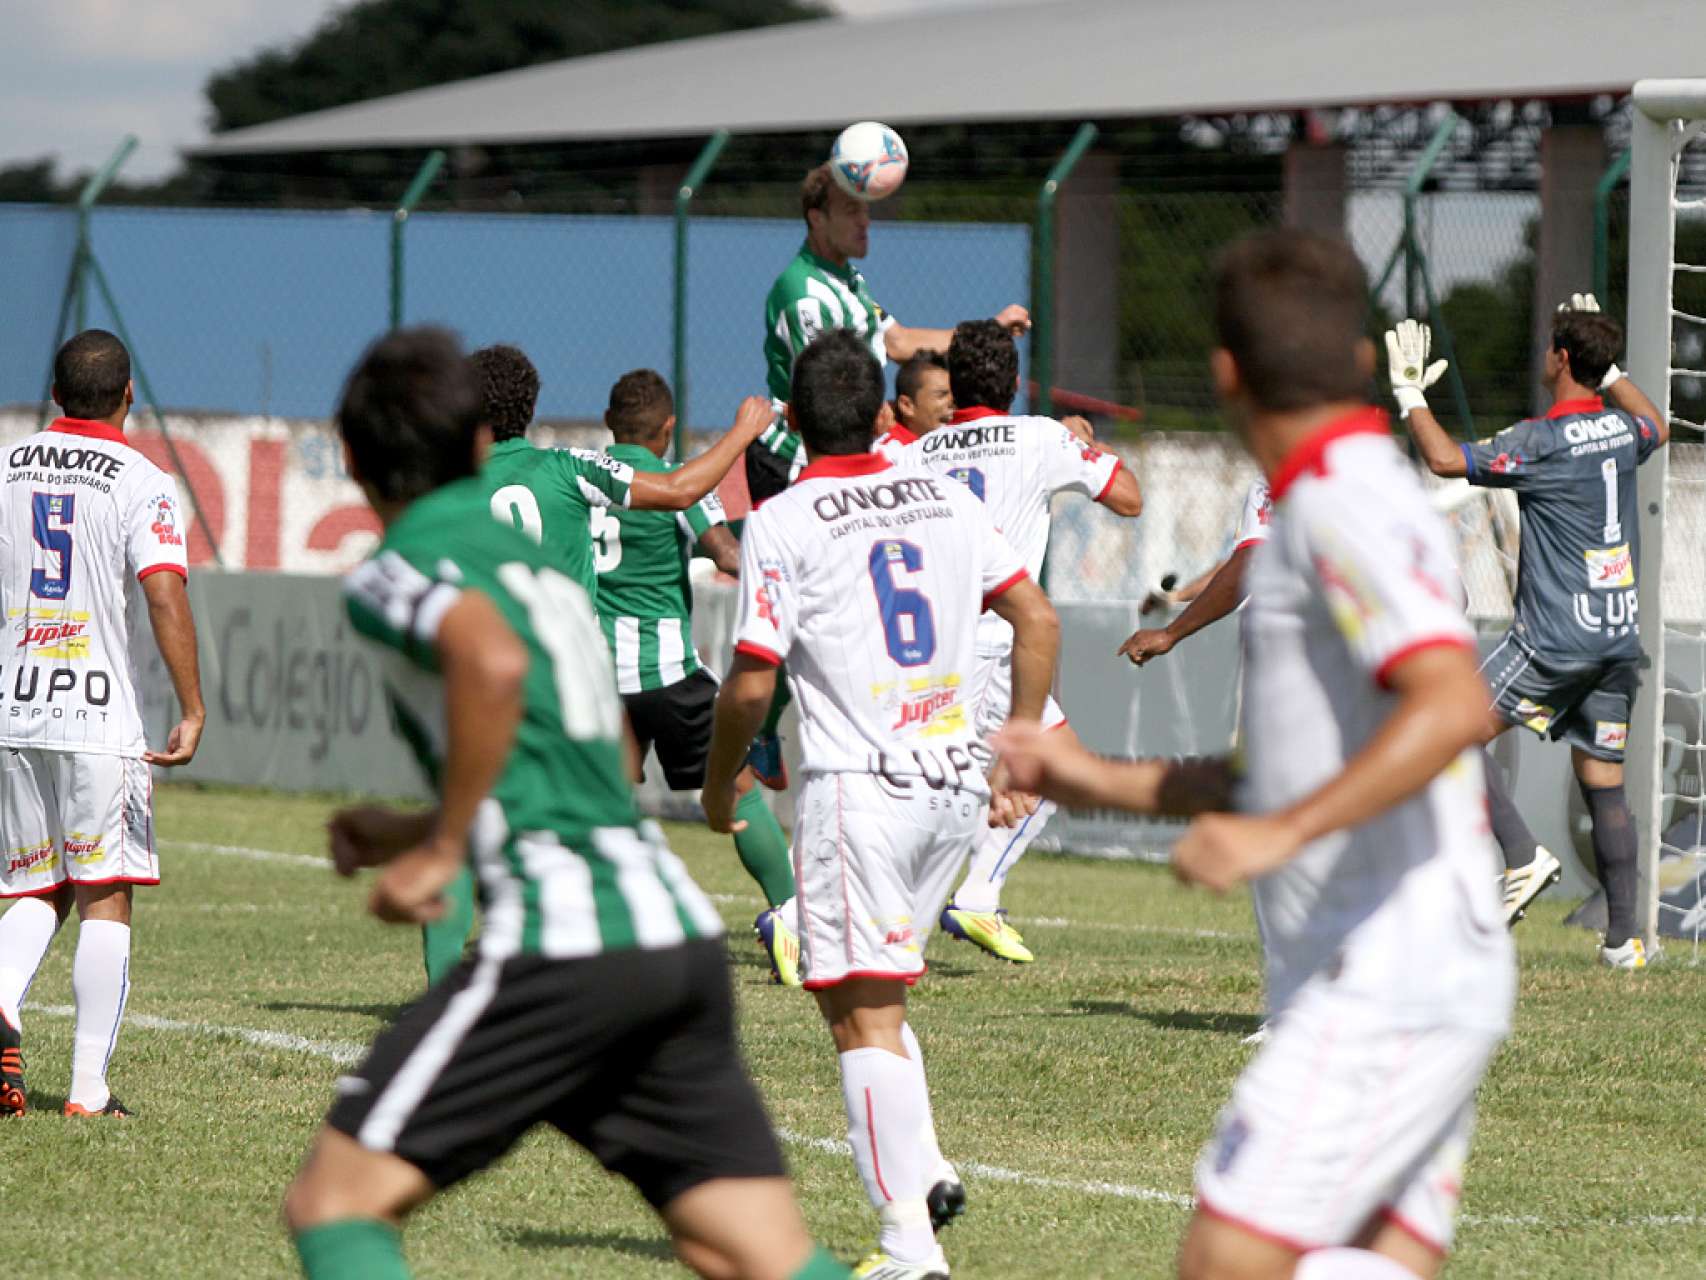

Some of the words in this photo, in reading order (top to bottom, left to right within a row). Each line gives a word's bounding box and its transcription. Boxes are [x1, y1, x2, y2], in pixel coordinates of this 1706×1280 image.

[922, 424, 1016, 454] CIANORTE
[9, 444, 126, 481] CIANORTE
[812, 476, 947, 523] CIANORTE
[31, 490, 76, 601] 5
[868, 537, 938, 668] 6
[1573, 589, 1639, 633] LUP
[0, 665, 111, 706] UPO
